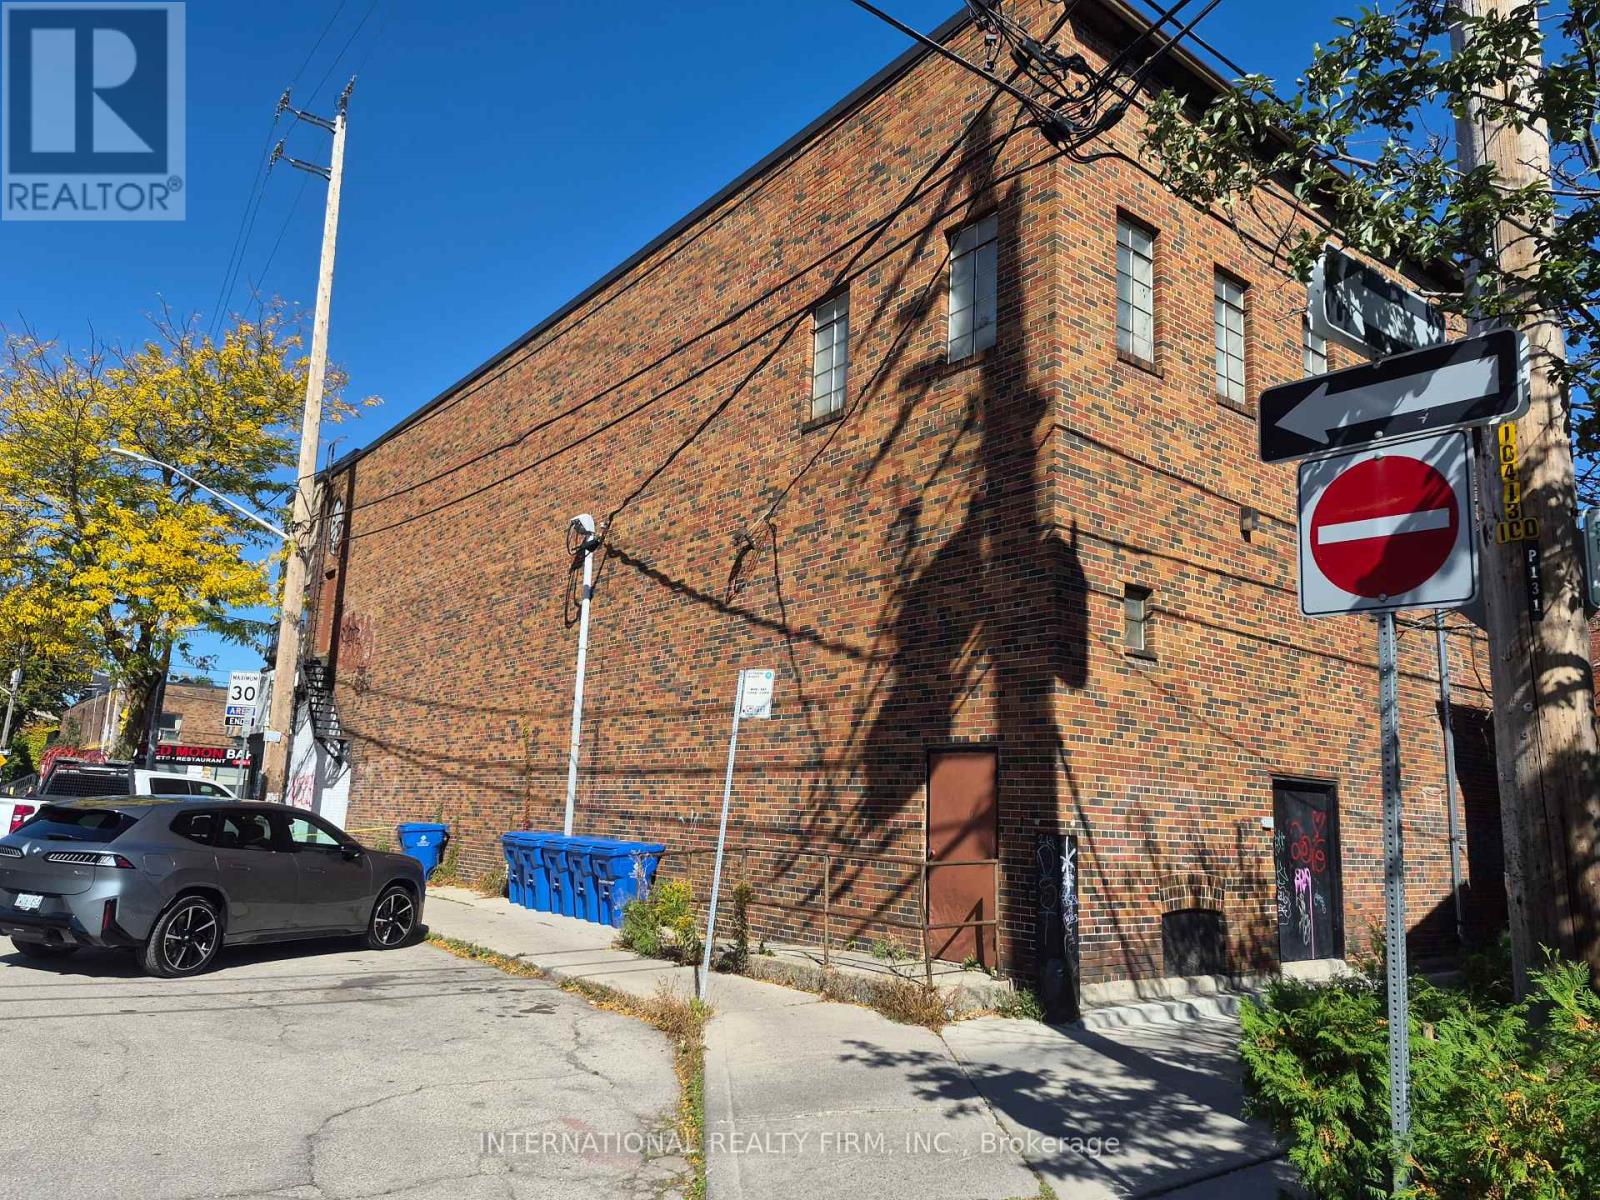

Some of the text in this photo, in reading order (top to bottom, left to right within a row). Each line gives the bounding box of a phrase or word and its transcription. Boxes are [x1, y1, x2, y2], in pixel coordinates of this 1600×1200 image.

[231, 685, 256, 702] 30
[176, 746, 224, 758] MOON
[176, 756, 227, 765] RESTAURANT
